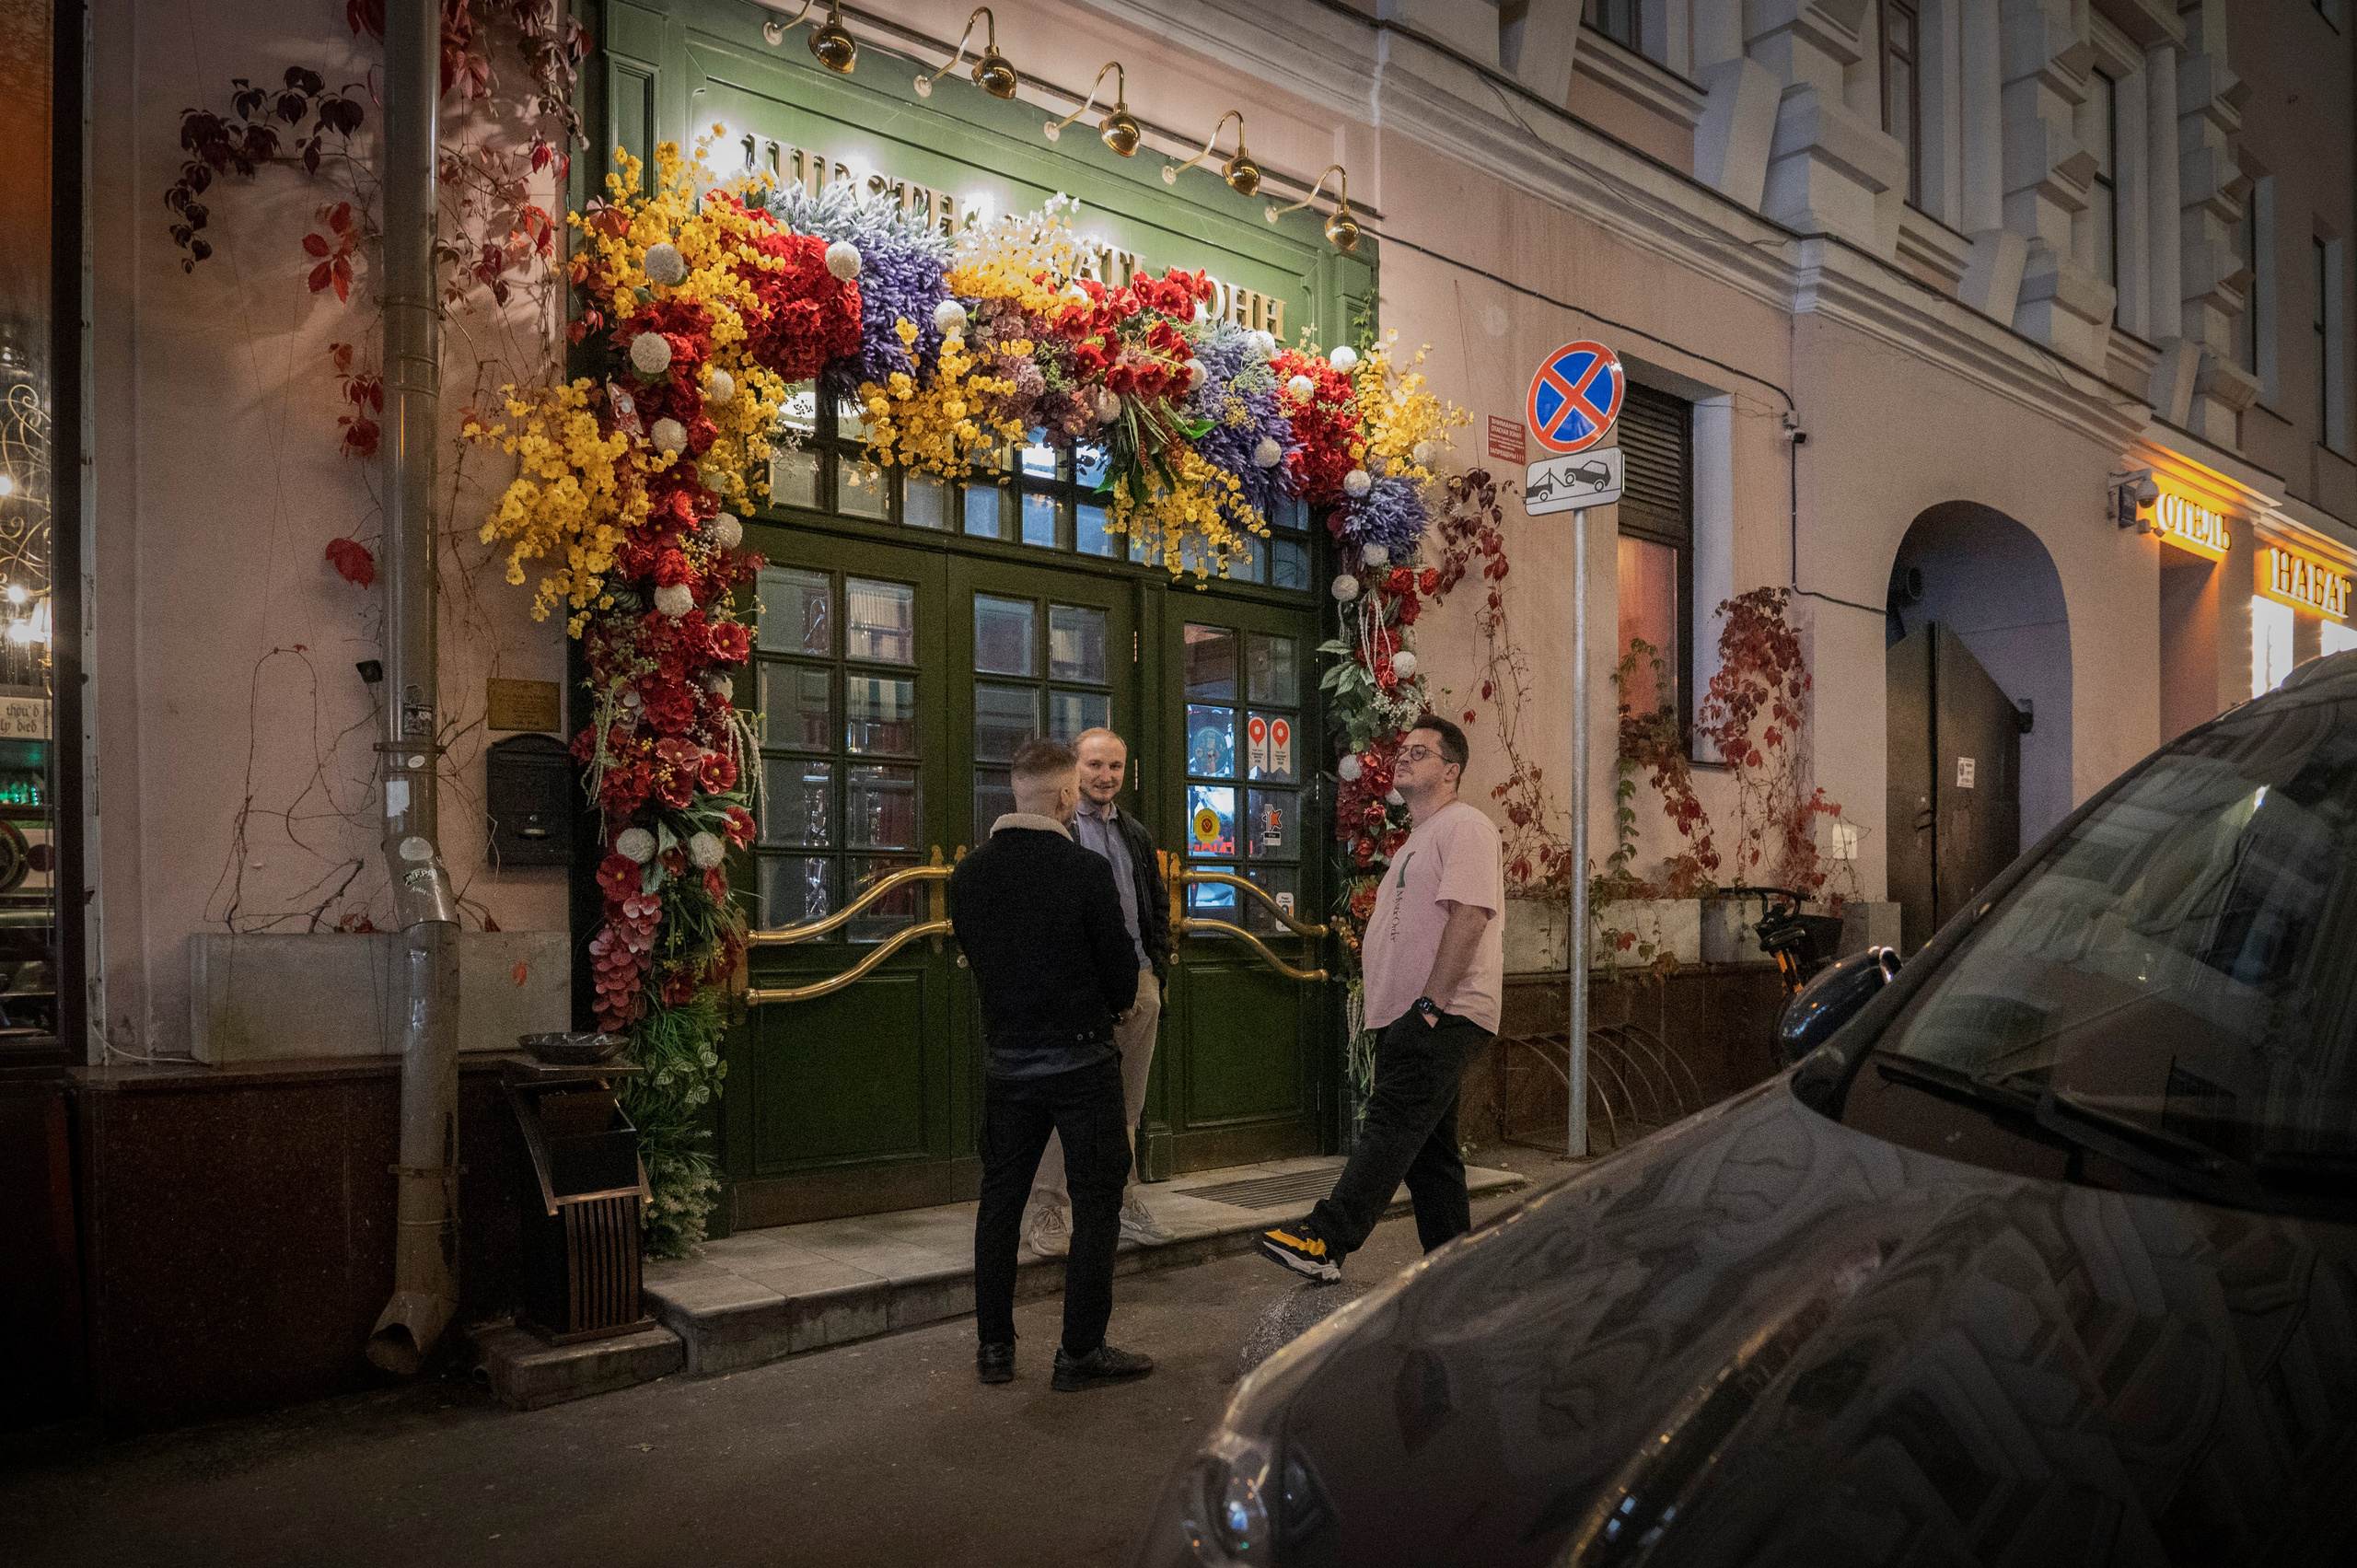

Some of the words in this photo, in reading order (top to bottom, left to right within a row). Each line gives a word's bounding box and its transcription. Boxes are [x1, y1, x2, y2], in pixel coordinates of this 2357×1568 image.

[1165, 264, 1287, 343] ОНН
[2155, 493, 2231, 553] ОТЕЛЬ
[2268, 547, 2351, 619] НАБАТ
